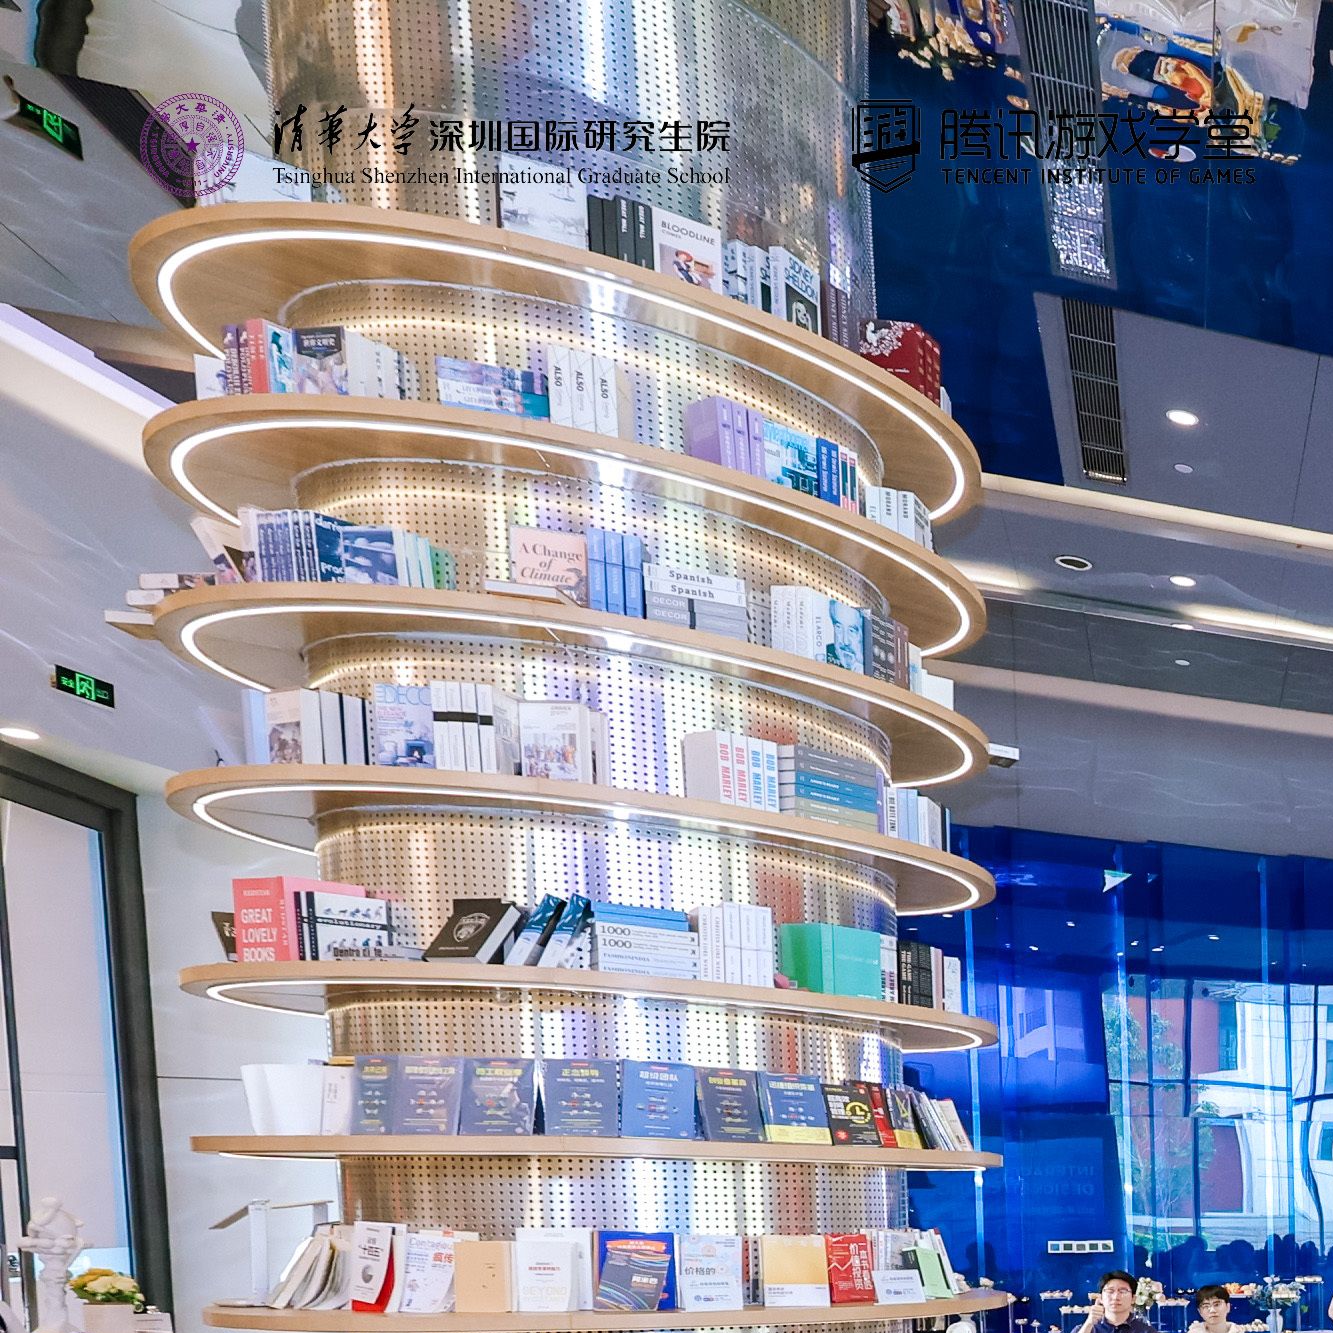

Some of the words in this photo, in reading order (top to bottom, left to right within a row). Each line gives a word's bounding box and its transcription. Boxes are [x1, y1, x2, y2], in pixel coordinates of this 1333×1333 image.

[660, 219, 716, 246] BLOODLINE
[788, 257, 814, 282] SIDNEY
[553, 365, 562, 388] ALSO
[576, 370, 584, 392] ALSO
[600, 377, 608, 399] ALSO
[519, 544, 530, 557] A
[532, 543, 583, 562] Change
[538, 558, 553, 572] of
[520, 567, 571, 585] Climate
[668, 569, 713, 585] Spanish
[670, 584, 715, 599] Spanish
[719, 743, 730, 761] BOB
[735, 747, 746, 765] BOB
[751, 750, 761, 768] BOB
[766, 753, 776, 771] BOB
[721, 766, 732, 799] MARLEY
[736, 769, 748, 802] MARLEY
[752, 772, 763, 805] MARLEY
[767, 776, 778, 808] MARLEY
[241, 908, 273, 924] GREAT
[242, 927, 278, 944] LOVELY
[600, 925, 631, 937] 1000
[602, 937, 632, 949] 1000
[243, 947, 275, 962] BOOKS
[684, 1266, 716, 1276] 价格的
